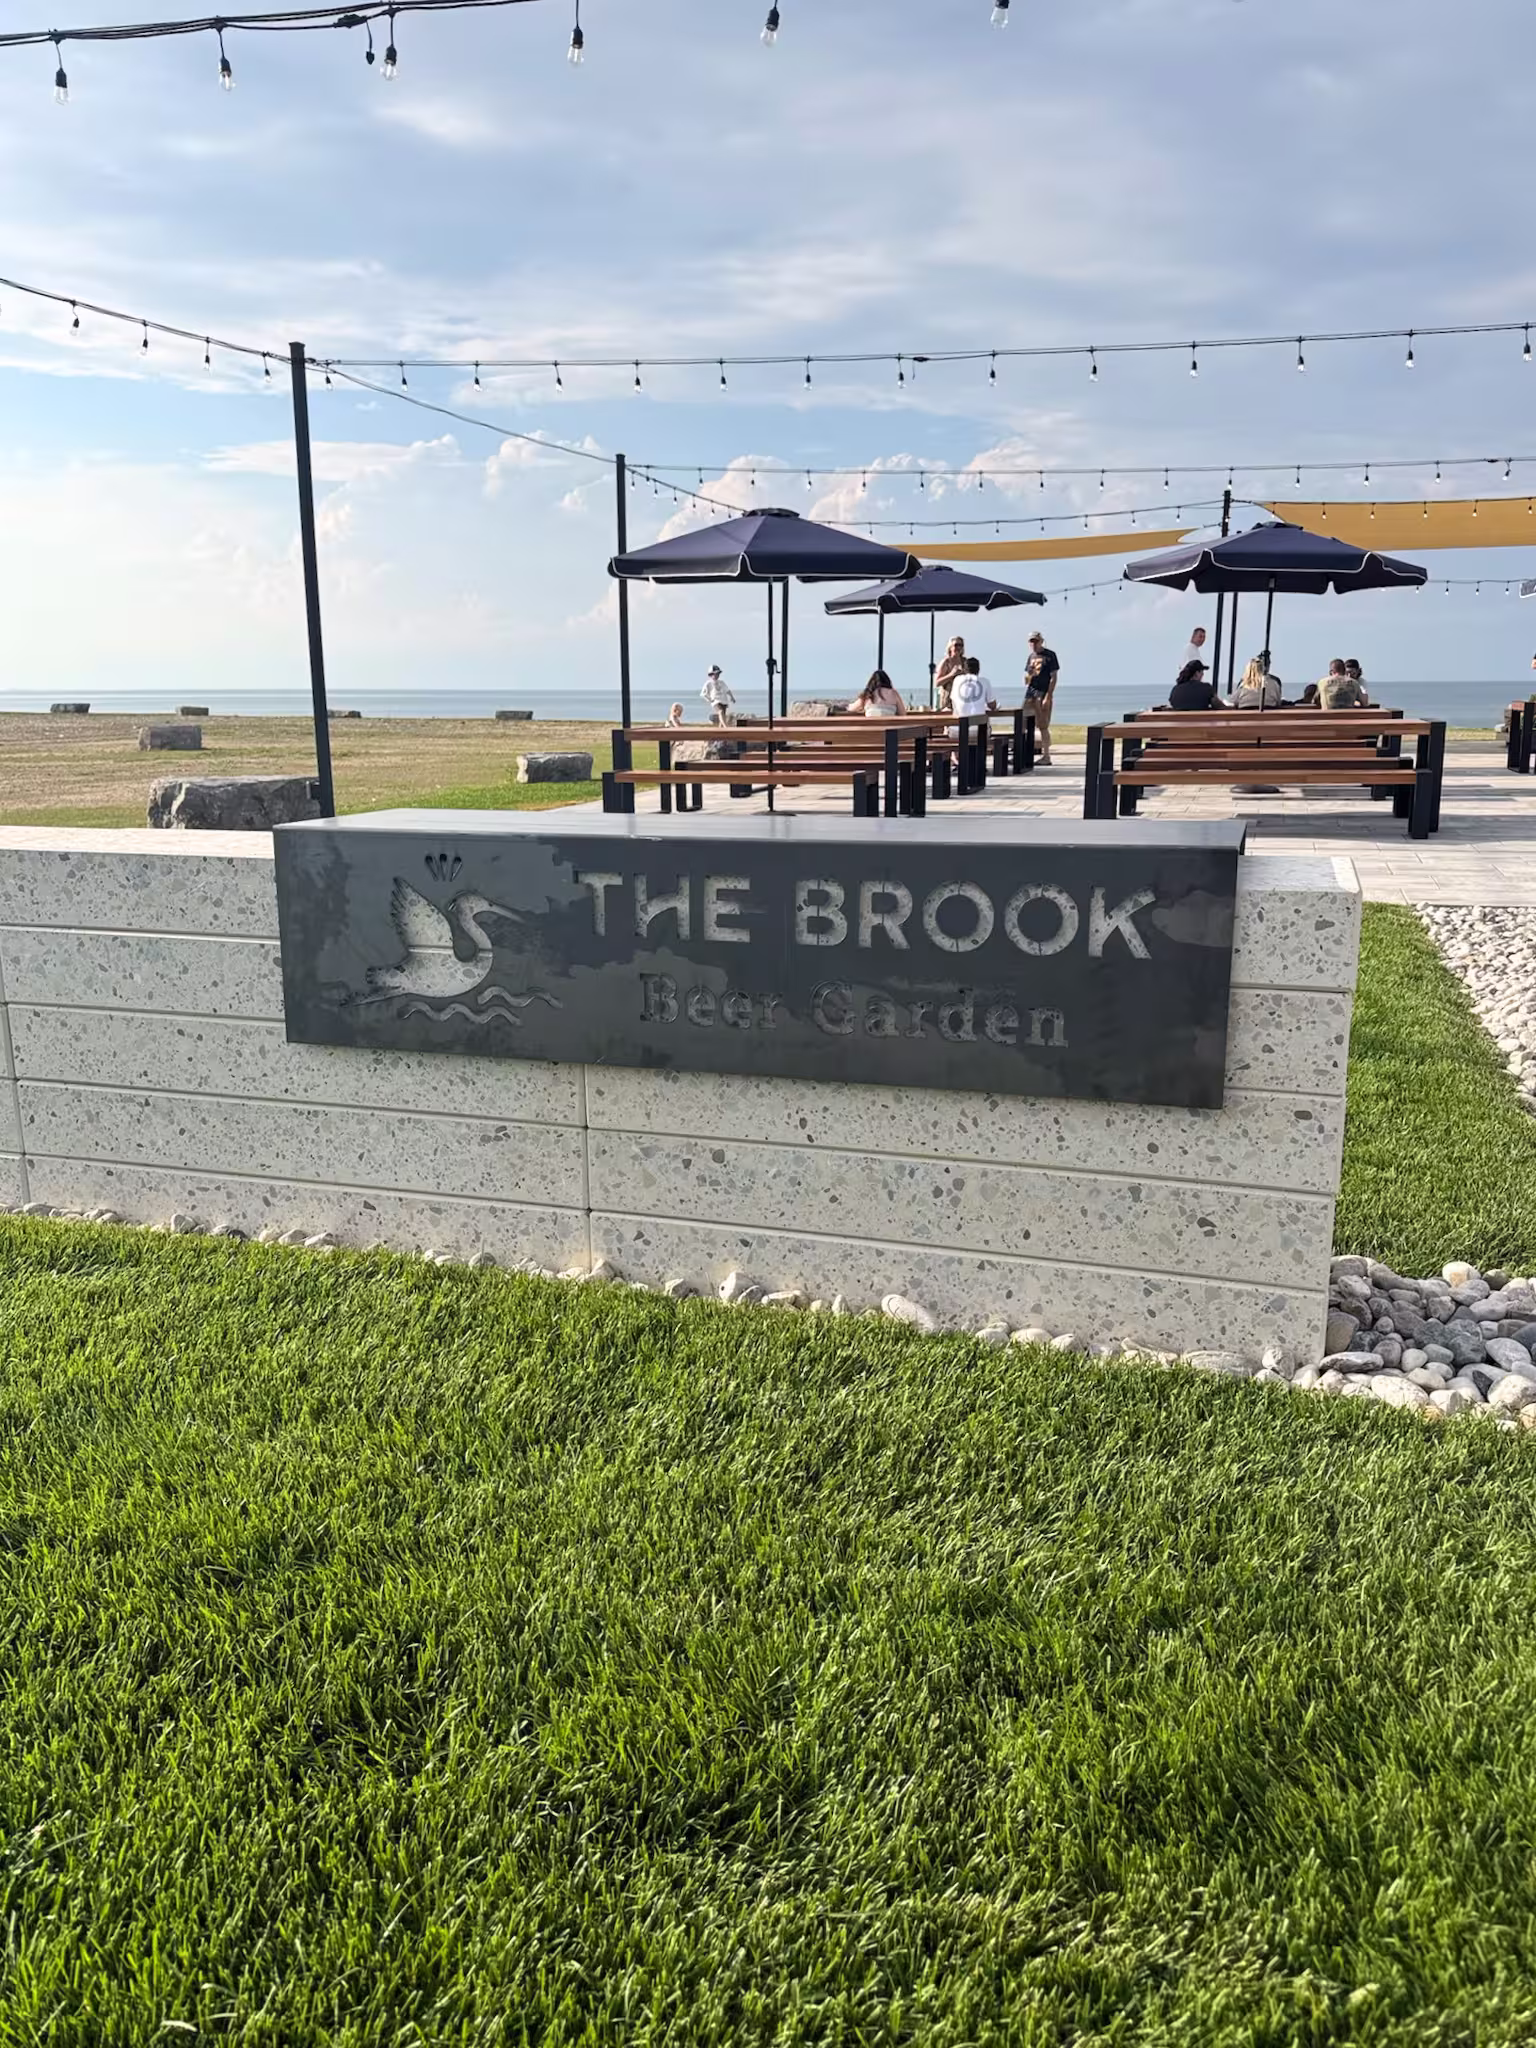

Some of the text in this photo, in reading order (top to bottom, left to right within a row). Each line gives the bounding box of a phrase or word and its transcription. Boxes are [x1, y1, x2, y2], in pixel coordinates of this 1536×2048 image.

[574, 871, 1156, 960] THE BROOK
[639, 973, 1069, 1048] Beer Garden
